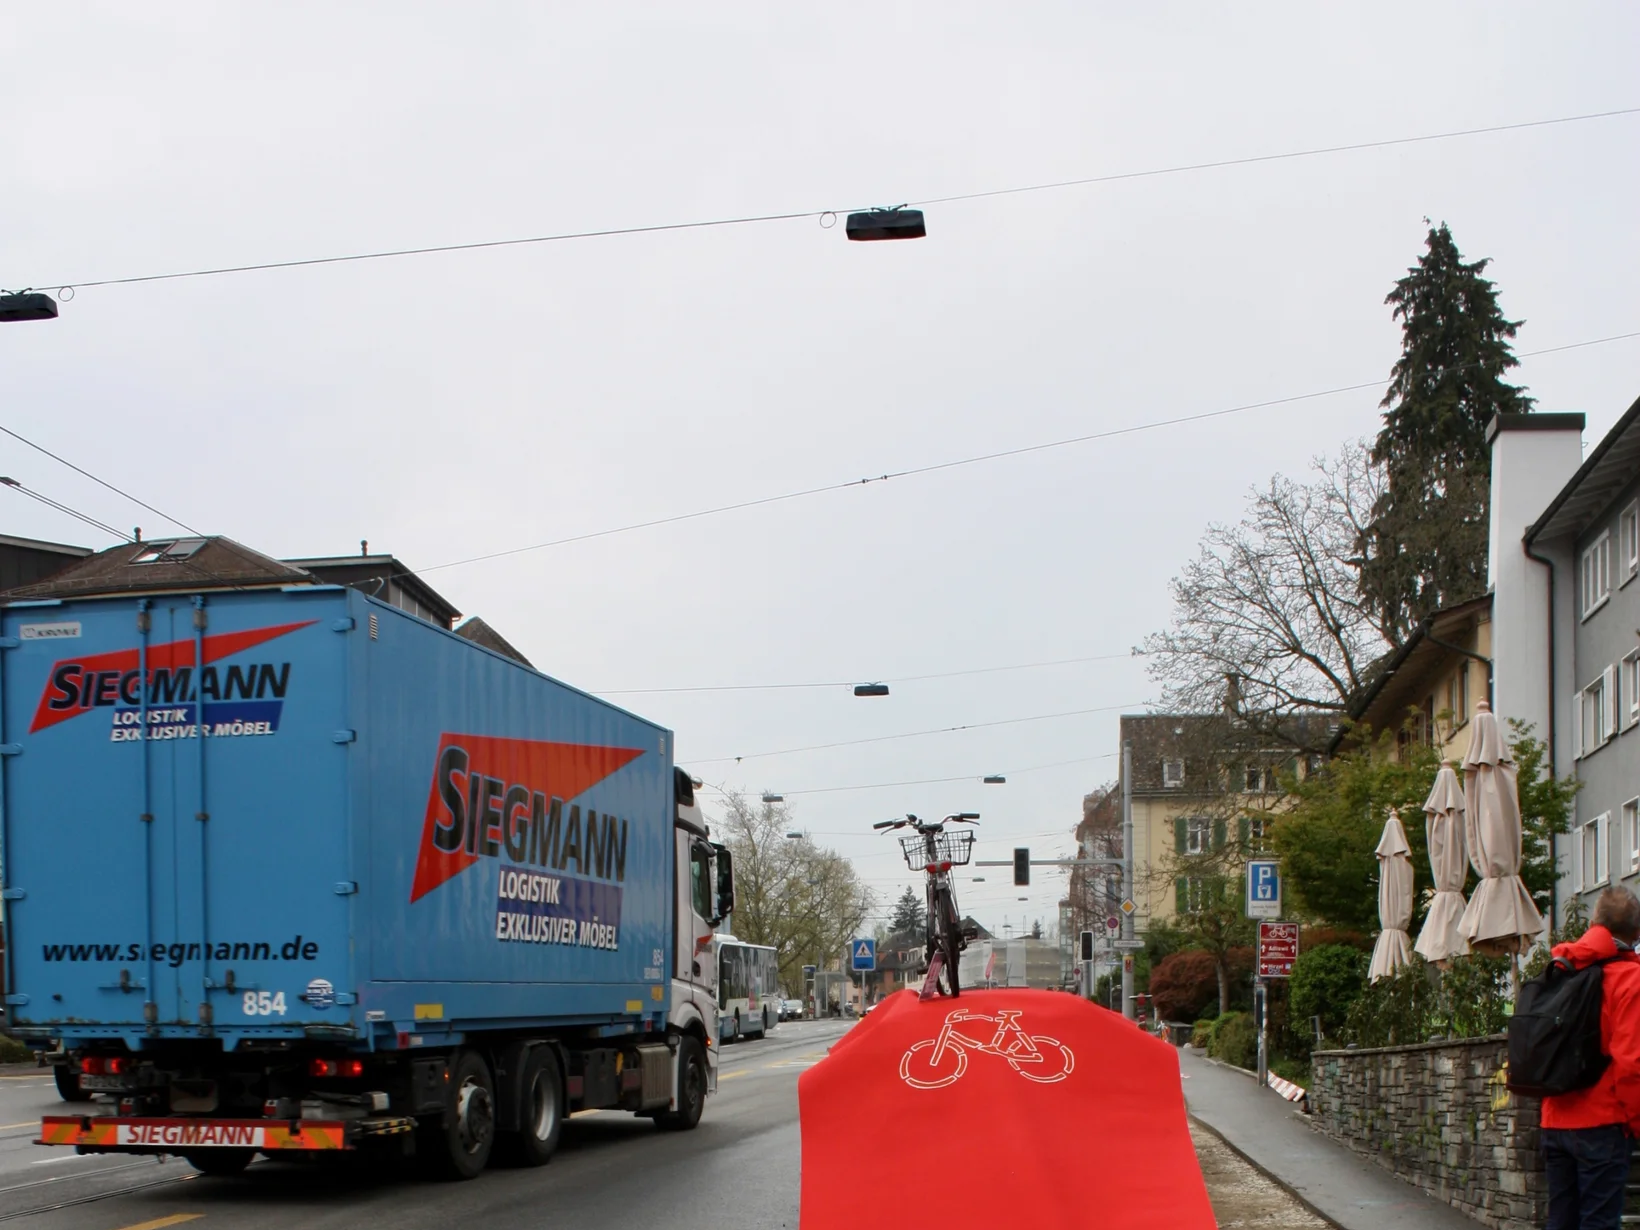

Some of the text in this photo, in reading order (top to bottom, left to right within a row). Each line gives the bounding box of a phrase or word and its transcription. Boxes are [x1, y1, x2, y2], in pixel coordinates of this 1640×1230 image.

[49, 662, 291, 710] SIEGMANN
[112, 708, 188, 726] LOGISTIK
[214, 719, 275, 737] MÖBEL
[433, 745, 628, 882] SIEGMANN
[499, 870, 560, 904] LOGISTIK
[497, 911, 619, 950] EXKLUSIVER MÖBEL
[42, 935, 319, 968] www.siegmann.de
[242, 991, 286, 1016] 854
[127, 1124, 254, 1145] SIEGMANN
